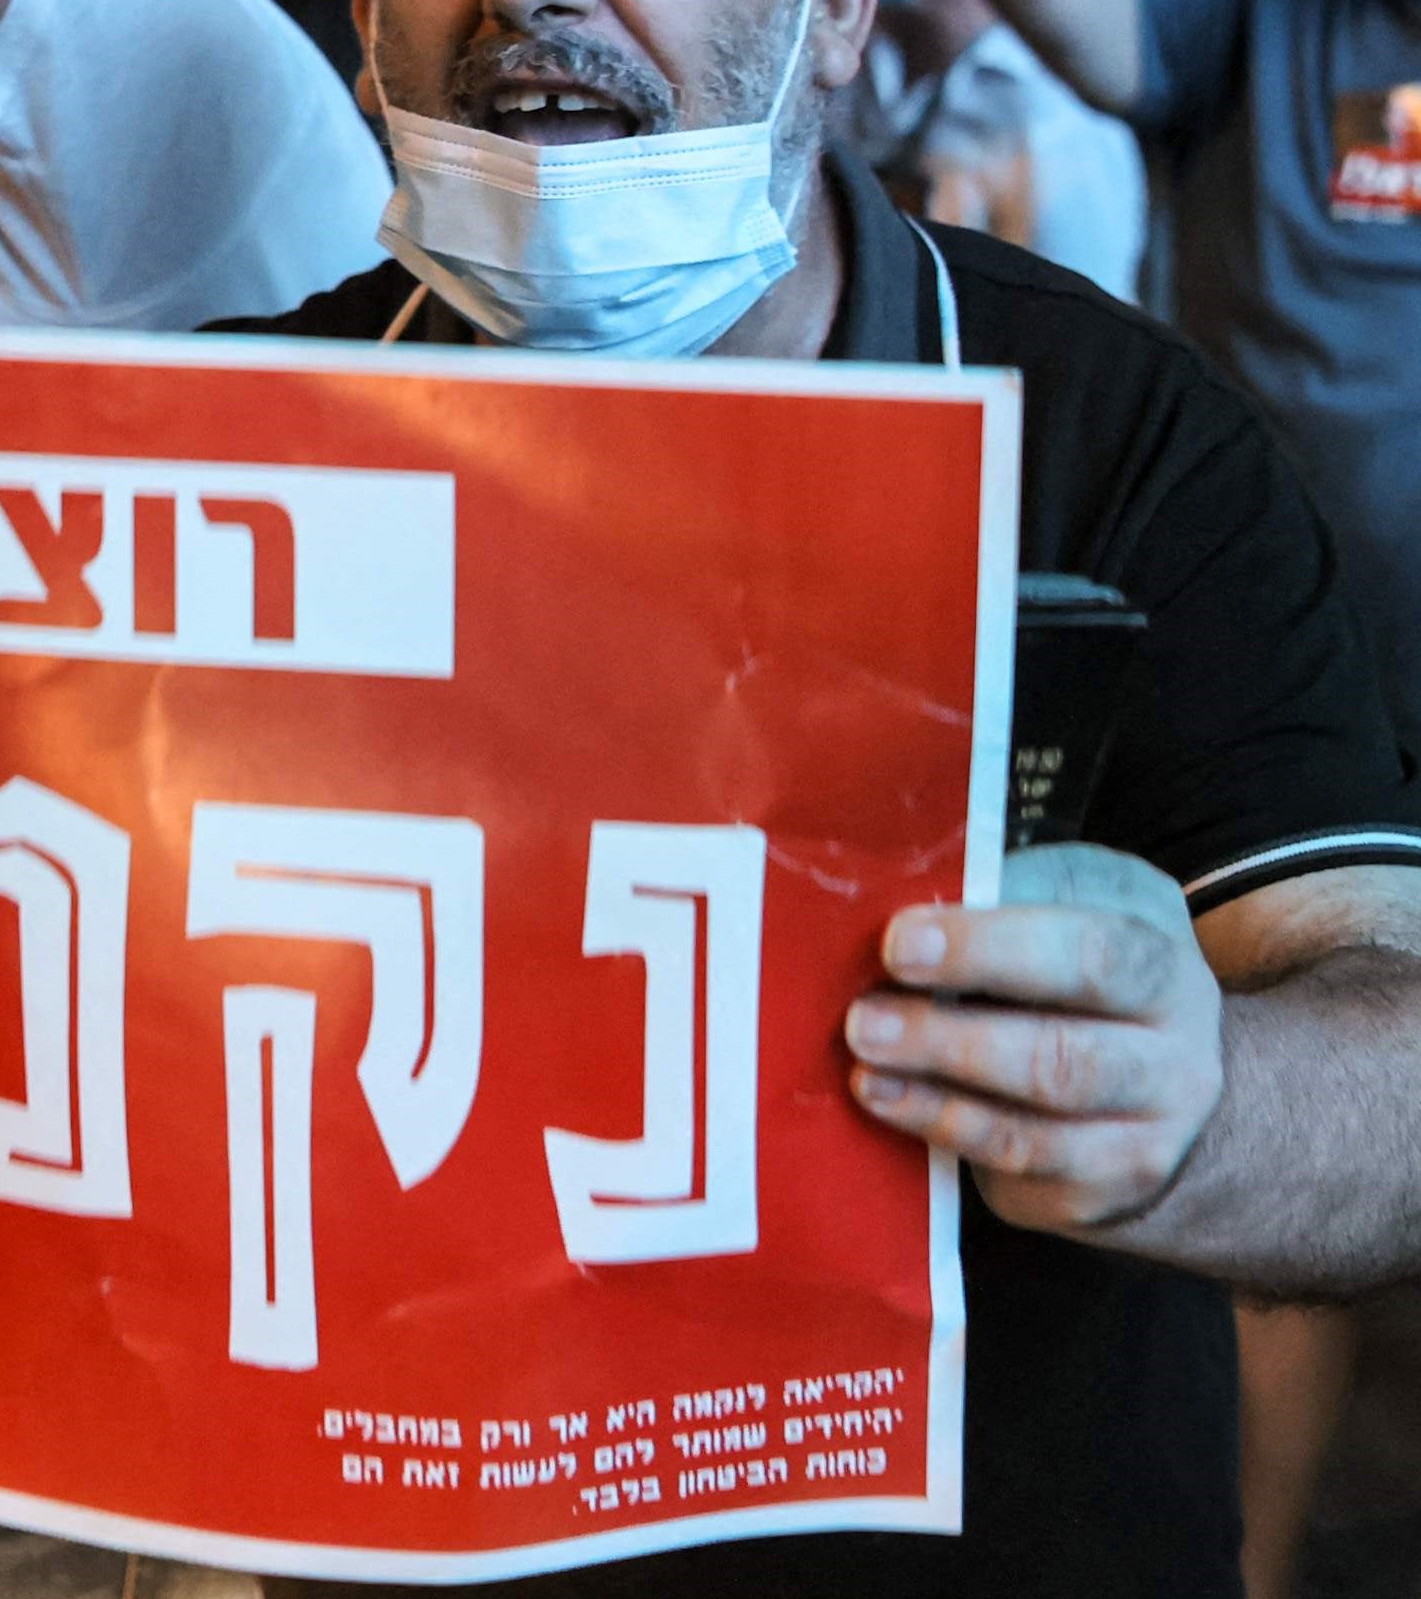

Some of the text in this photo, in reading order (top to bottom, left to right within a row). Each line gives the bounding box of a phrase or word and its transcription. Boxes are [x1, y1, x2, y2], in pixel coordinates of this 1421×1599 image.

[606, 1399, 656, 1434] היא
[673, 1382, 767, 1422] לנקמה
[480, 1419, 532, 1453] ורק
[672, 1422, 767, 1458] שמותר
[341, 1453, 384, 1485] הם
[479, 1452, 577, 1490] לעשות
[594, 1437, 656, 1474] להם
[805, 1447, 887, 1480] כוחות
[402, 1458, 461, 1490] זאת
[679, 1457, 788, 1499] הביטחון
